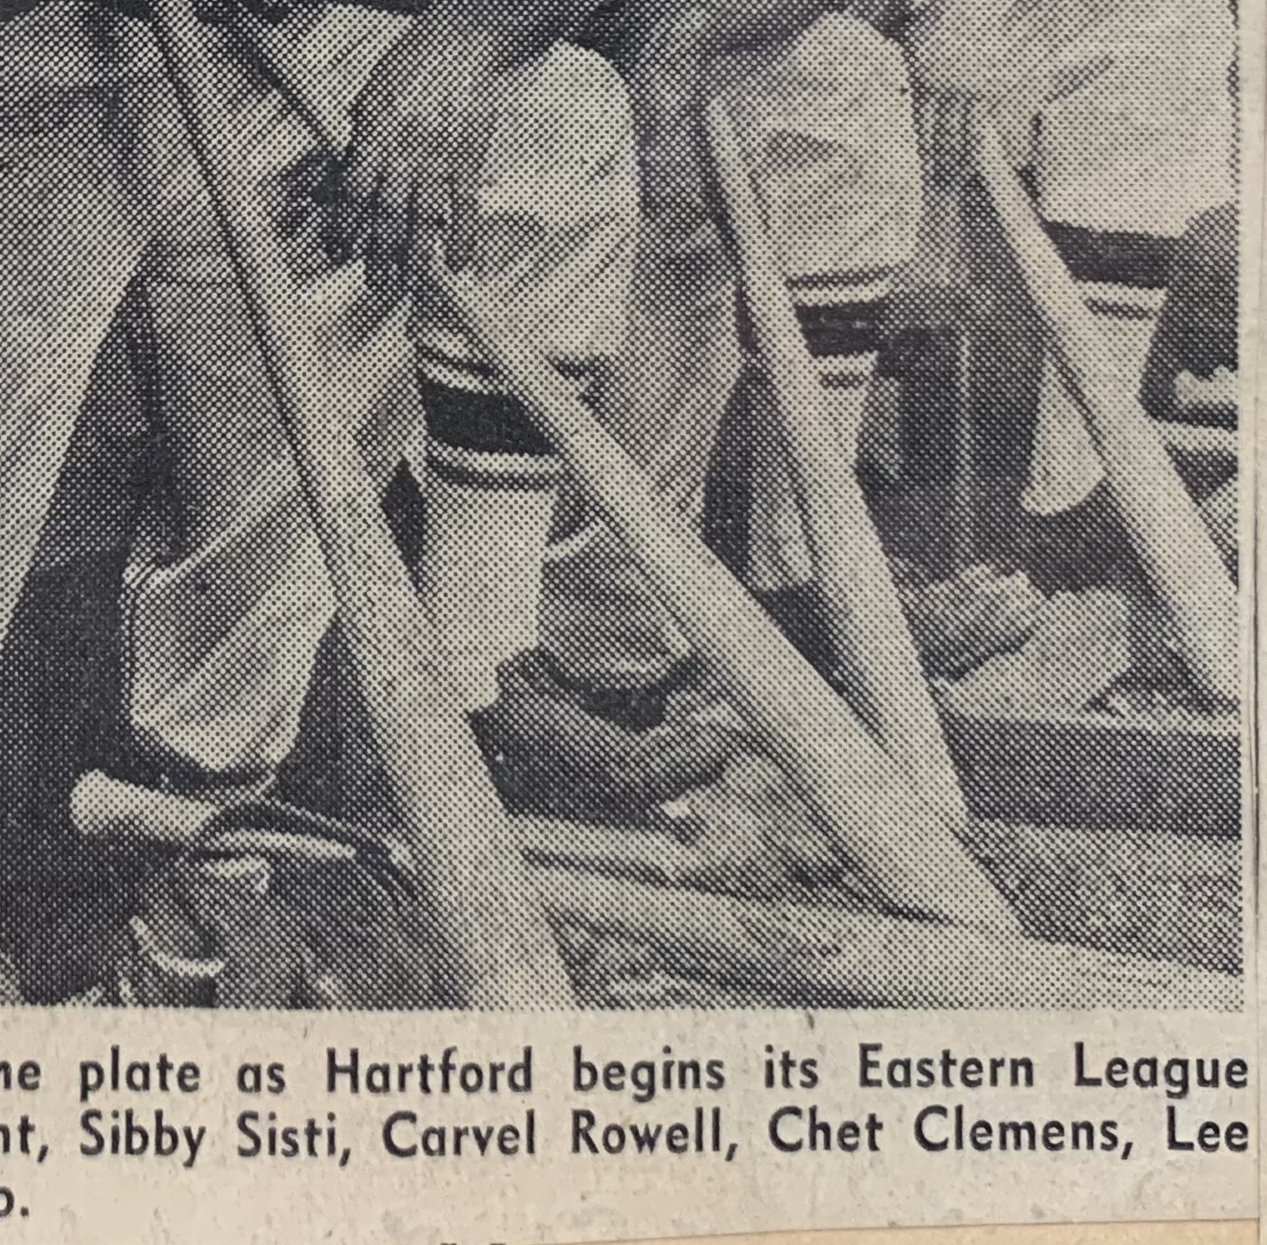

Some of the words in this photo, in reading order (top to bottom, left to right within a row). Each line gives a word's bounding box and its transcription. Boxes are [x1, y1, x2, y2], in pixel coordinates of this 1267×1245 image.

[79, 1044, 201, 1103] plate
[236, 1062, 286, 1095] as
[326, 1045, 533, 1095] Hartford
[573, 1045, 725, 1104] begins
[764, 1044, 819, 1090] its
[859, 1042, 1034, 1089] Eastern
[1074, 1041, 1249, 1100] League
[79, 1108, 206, 1169] Sibby
[236, 1110, 351, 1167] Sisti,
[382, 1108, 536, 1159] Carvel
[571, 1106, 738, 1162] Rowell,
[768, 1104, 884, 1153] Chet
[914, 1103, 1134, 1161] Clemens,
[1166, 1105, 1249, 1153] Lee
